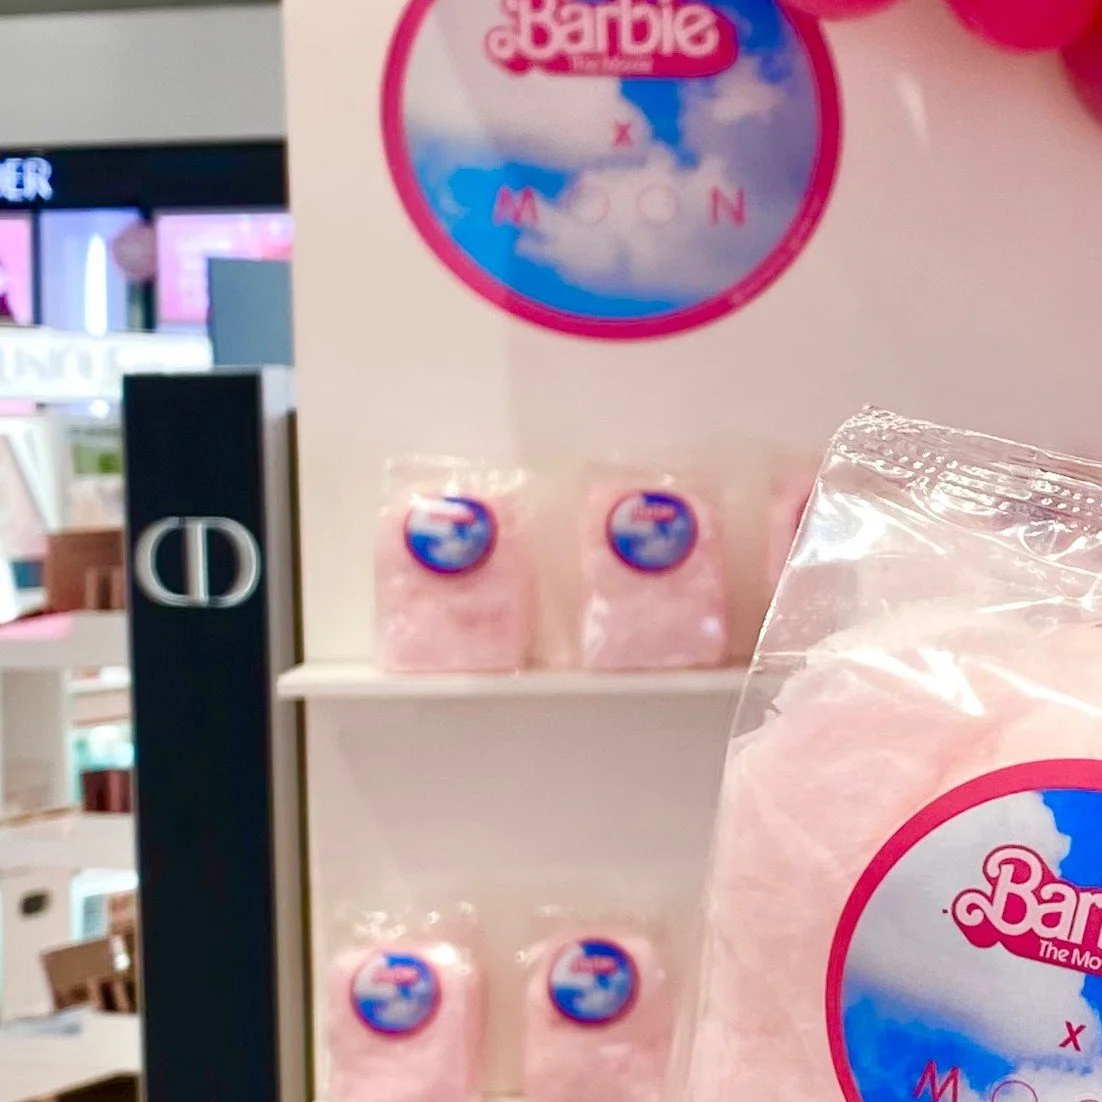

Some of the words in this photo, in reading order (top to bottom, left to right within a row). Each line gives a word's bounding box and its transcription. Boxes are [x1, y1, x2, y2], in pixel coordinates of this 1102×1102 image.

[488, 0, 720, 59] Barbie
[0, 157, 53, 201] ER
[1038, 939, 1069, 963] The
